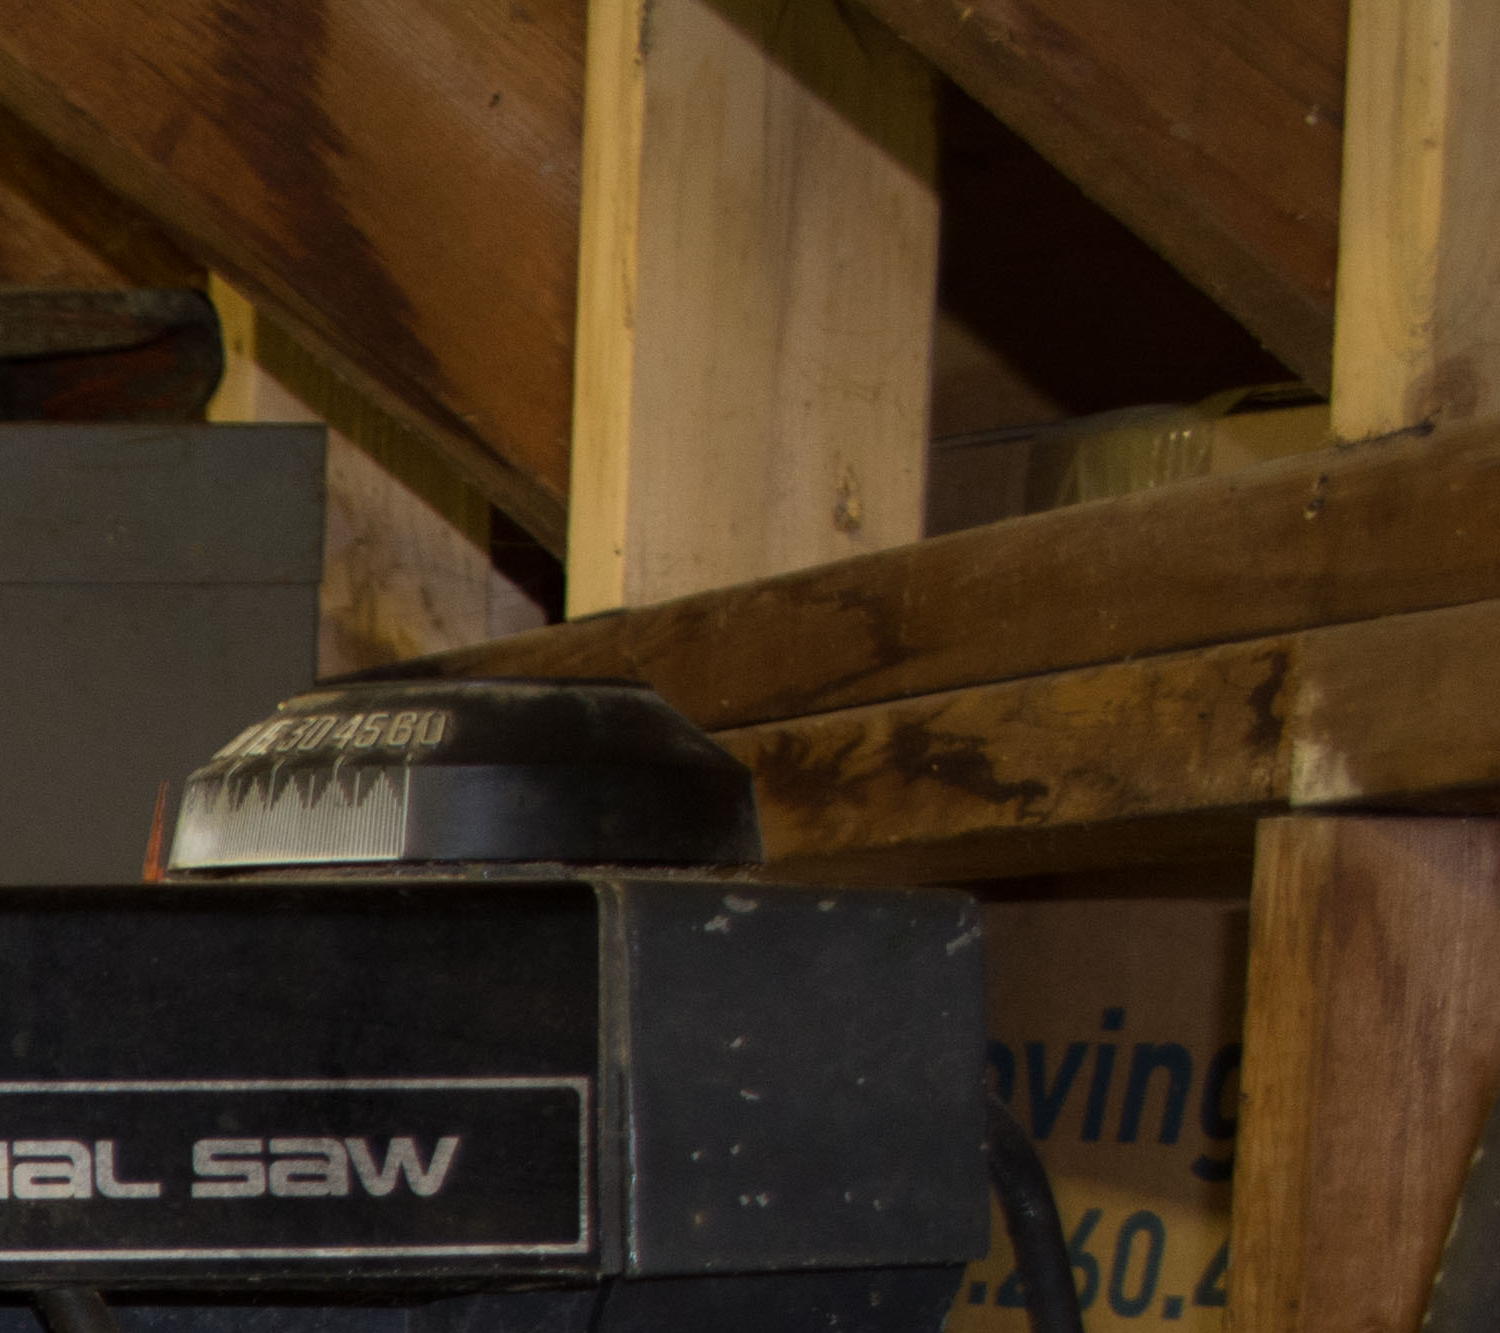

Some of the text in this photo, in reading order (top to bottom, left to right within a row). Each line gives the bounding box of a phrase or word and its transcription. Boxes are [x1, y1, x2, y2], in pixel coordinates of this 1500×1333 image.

[275, 716, 340, 752] 30
[332, 713, 389, 750] 45
[386, 710, 449, 747] 60
